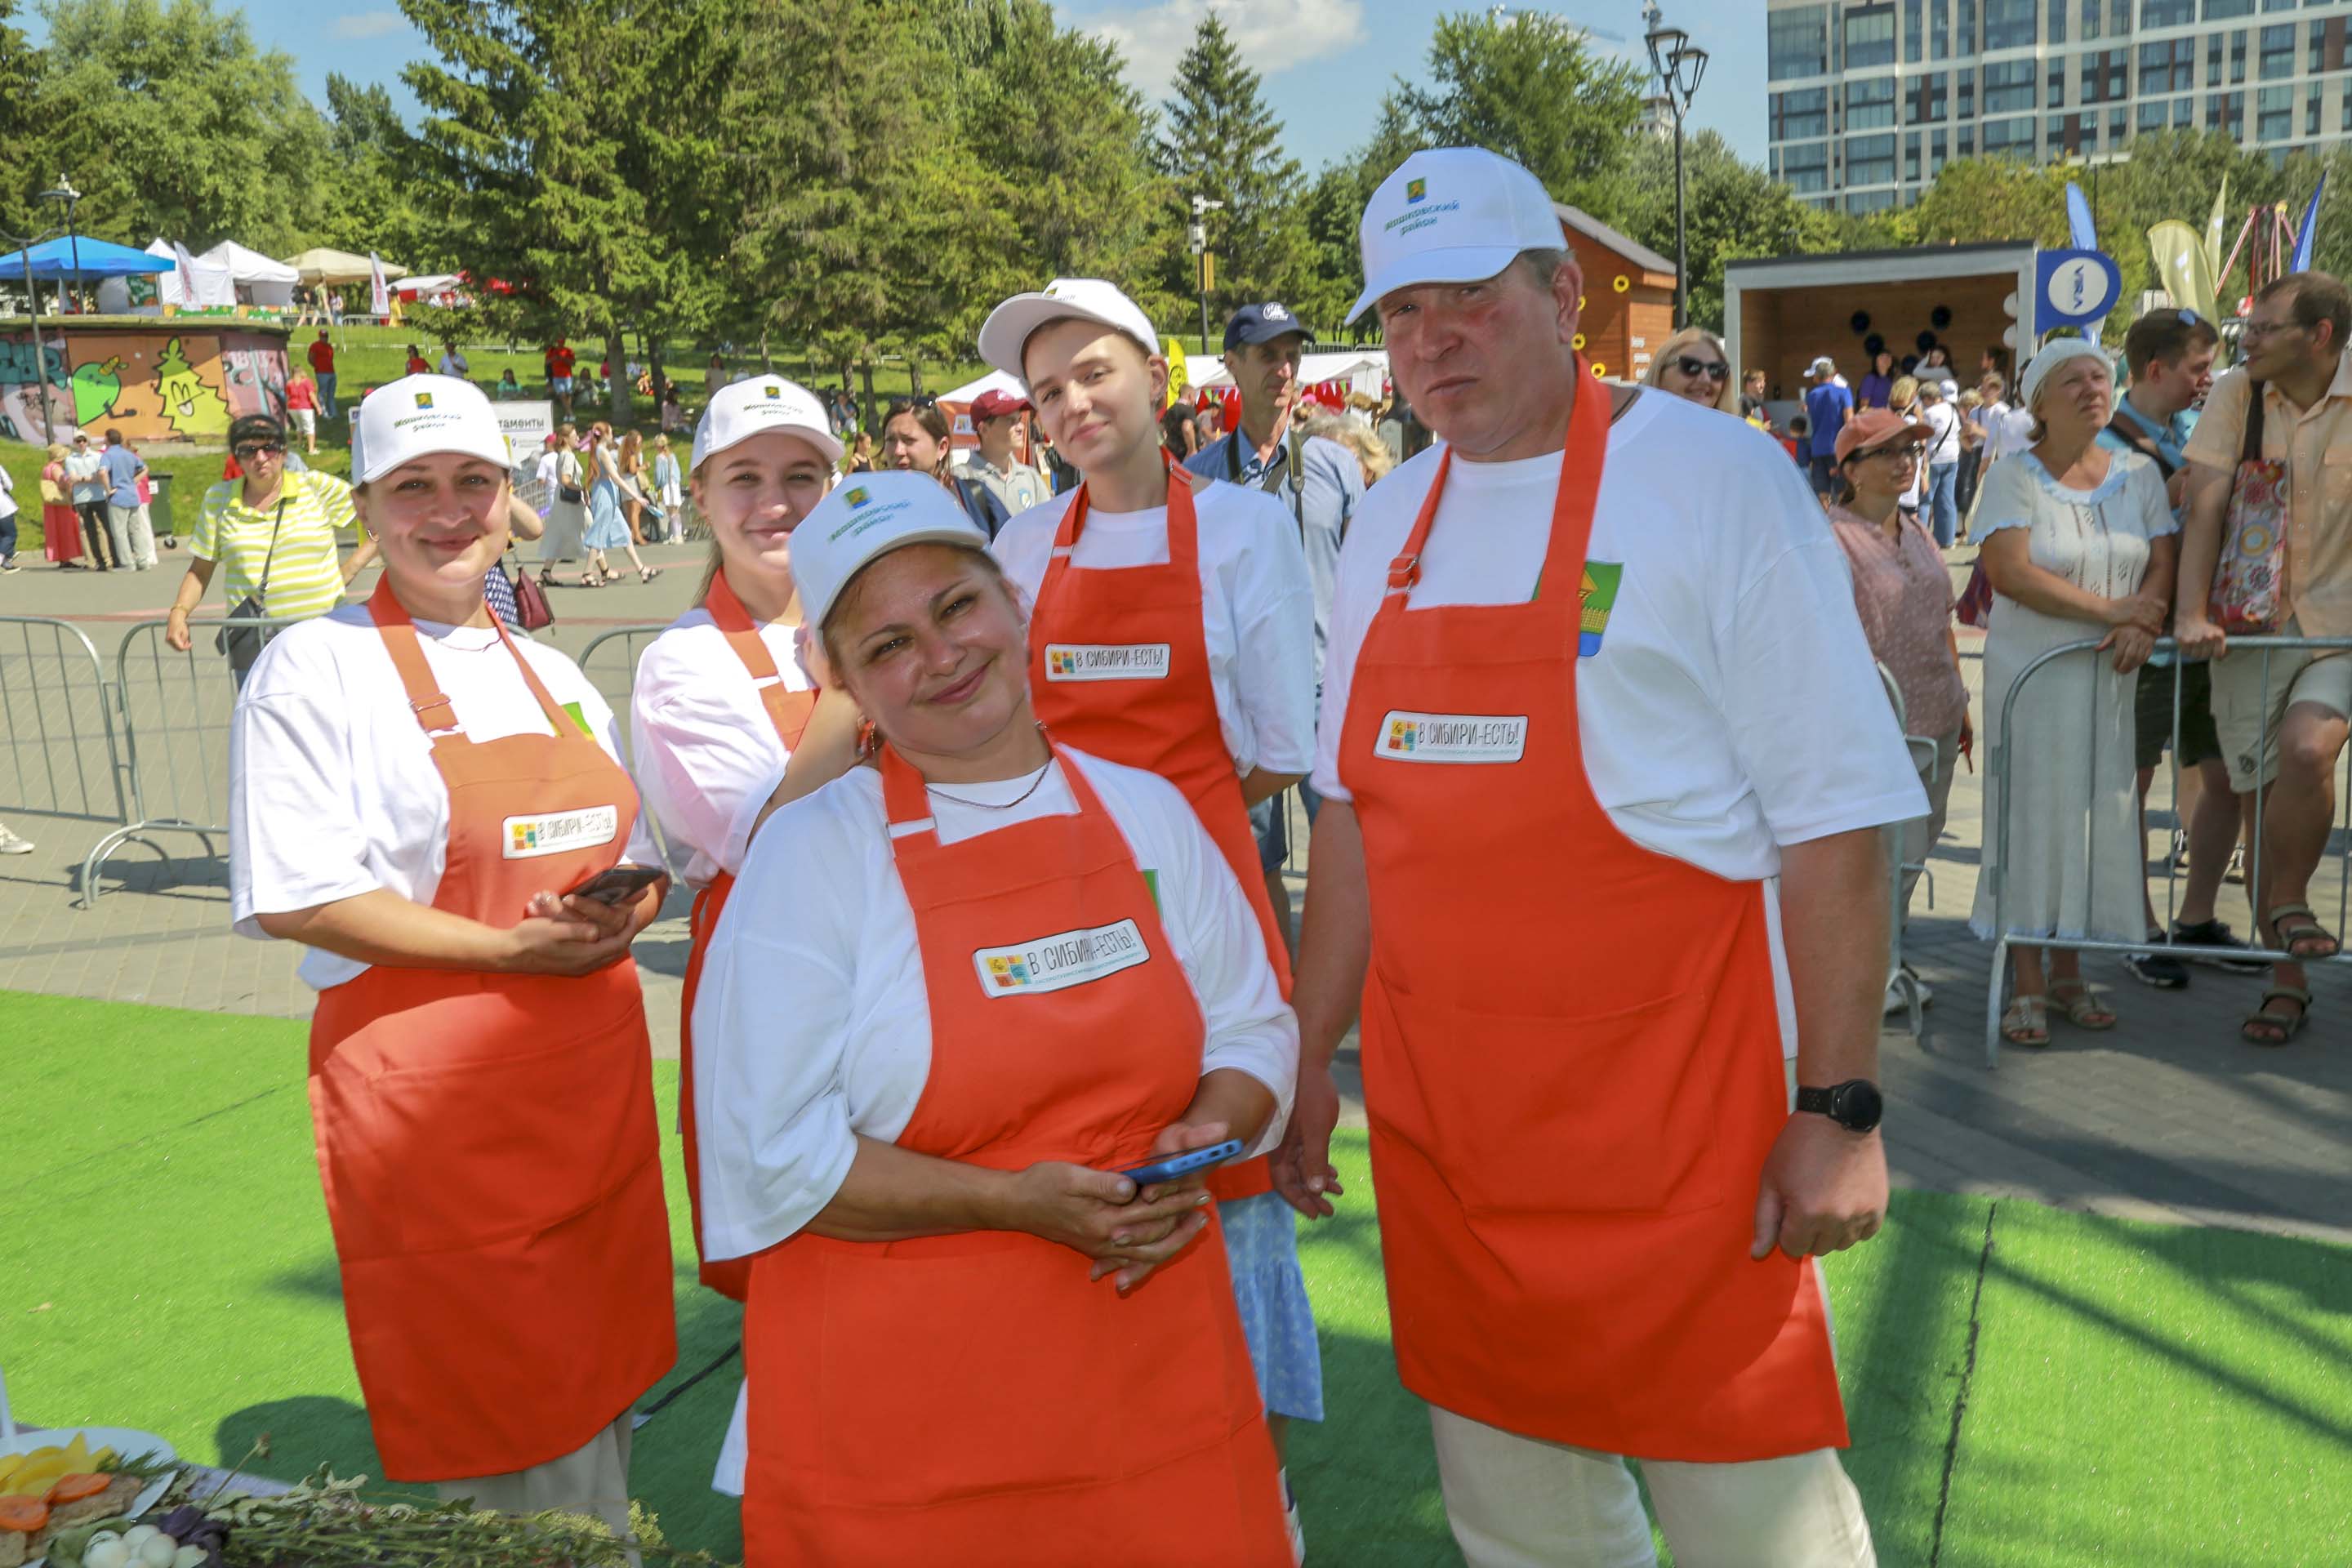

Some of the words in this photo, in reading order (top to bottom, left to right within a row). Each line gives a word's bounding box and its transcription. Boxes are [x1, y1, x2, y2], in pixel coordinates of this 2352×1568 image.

[1076, 651, 1083, 667] В
[1086, 648, 1164, 667] СИБИРИ-ЕСТЬ!
[1419, 722, 1426, 744] В
[1429, 722, 1520, 745] СИБИРИ-ЕСТЬ!
[1027, 951, 1040, 975] В
